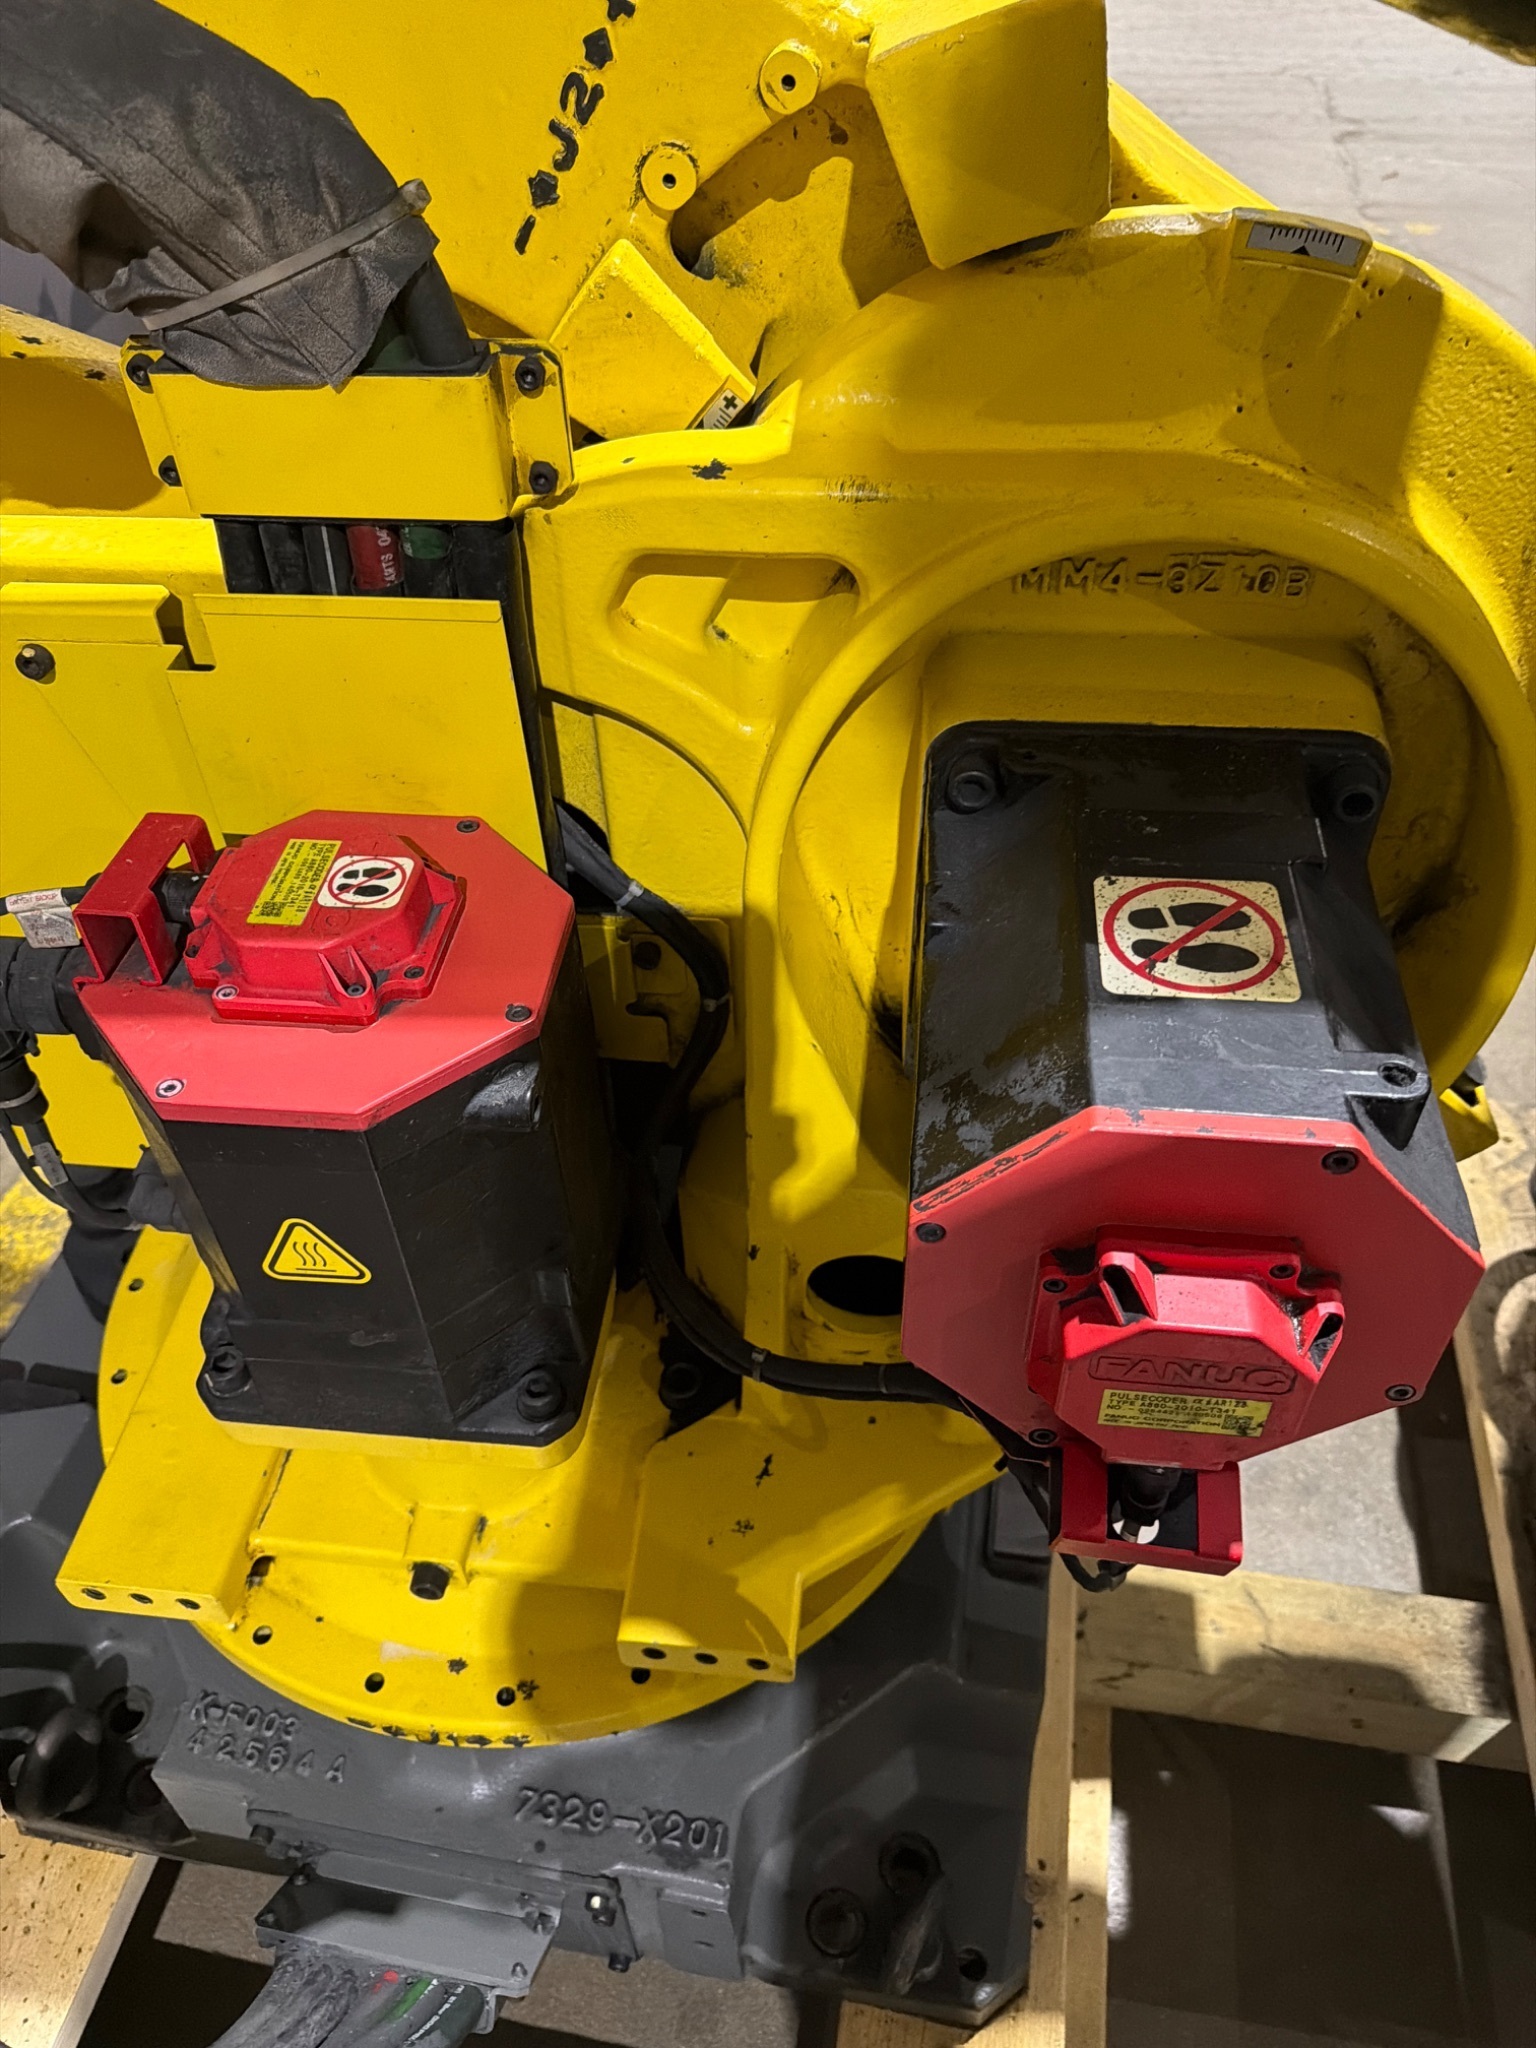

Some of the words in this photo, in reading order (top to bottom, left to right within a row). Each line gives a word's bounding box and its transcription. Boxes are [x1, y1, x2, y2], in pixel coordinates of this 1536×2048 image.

[548, 71, 605, 172] J2
[1095, 1355, 1290, 1390] FANUC
[1108, 1399, 1136, 1407] TYPE
[1109, 1392, 1188, 1405] PULSECODER
[1143, 1416, 1220, 1427] CORPORATION
[514, 1786, 730, 1858] 7329-X201
